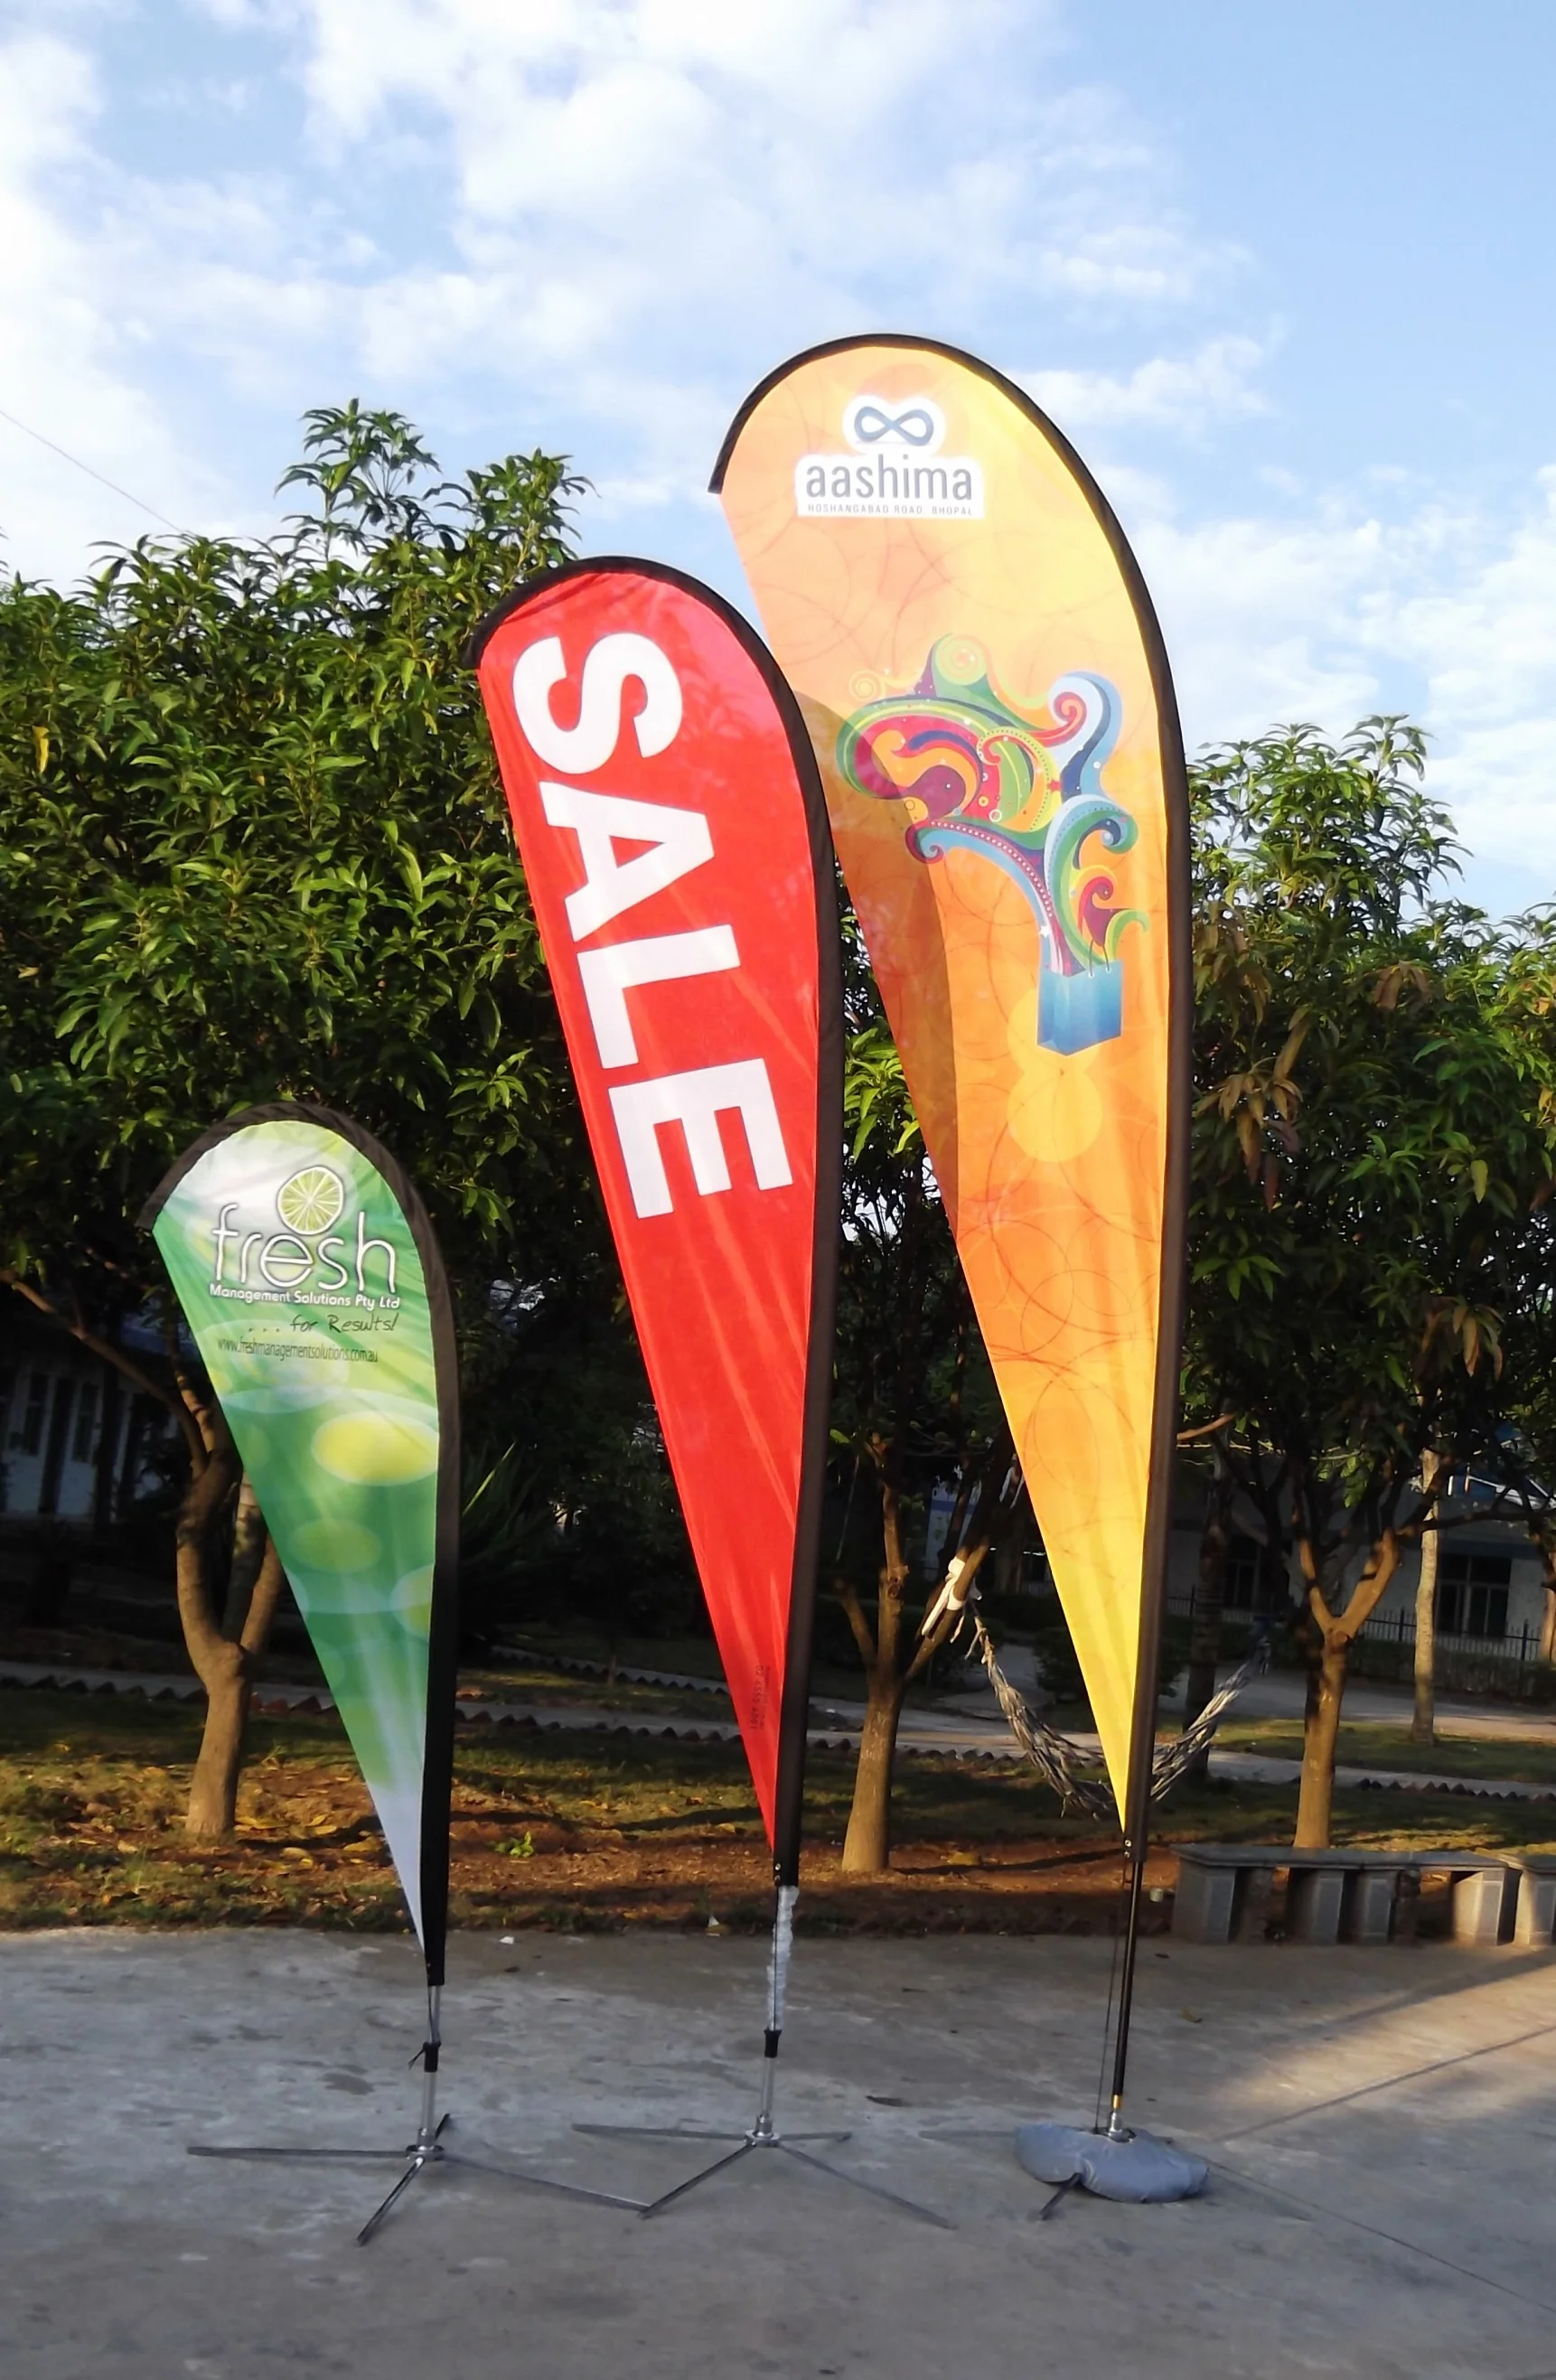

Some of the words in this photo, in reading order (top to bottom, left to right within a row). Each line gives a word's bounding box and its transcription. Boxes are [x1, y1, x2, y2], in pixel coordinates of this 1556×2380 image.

[806, 454, 972, 501] aashima
[807, 503, 889, 515] HOSHANGABAD
[932, 506, 972, 516] BHOPAL
[512, 632, 792, 1219] SALE
[211, 1202, 397, 1294] fresh
[210, 1284, 291, 1304] Management
[295, 1289, 351, 1307] Solutions
[355, 1294, 375, 1311] Pty
[380, 1297, 400, 1309] Ltd
[289, 1314, 319, 1332] for
[327, 1313, 398, 1333] Results!
[217, 1335, 379, 1363] www.freshmanagementsolutions.com.au
